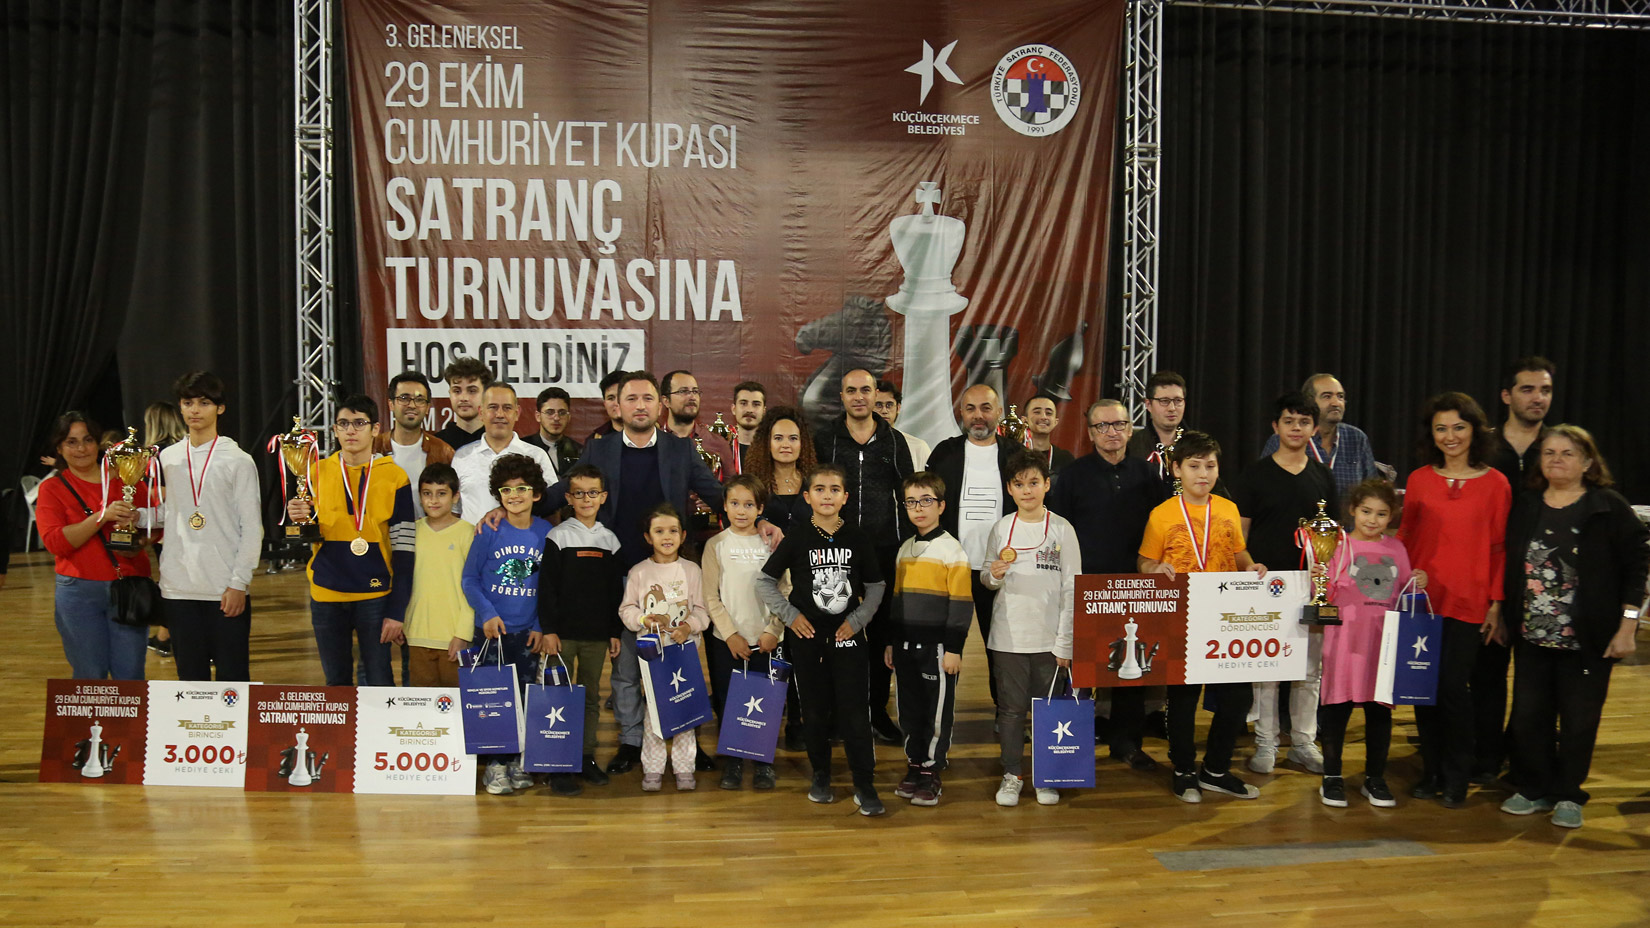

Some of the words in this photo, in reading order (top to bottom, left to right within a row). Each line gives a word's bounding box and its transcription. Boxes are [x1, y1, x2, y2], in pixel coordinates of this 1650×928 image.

[386, 24, 402, 47] 3.
[408, 24, 523, 50] GELENEKSEL
[385, 61, 430, 108] 29
[440, 55, 524, 109] EKİM
[993, 66, 1005, 103] TÜRKİYE
[1006, 47, 1044, 63] SATRANÇ
[1049, 51, 1078, 106] FEDERASYONU
[892, 111, 980, 125] KÜÇÜKÇEKMECE
[907, 125, 966, 136] BELEDİYESİ
[385, 112, 607, 167] CUMHURİYET
[617, 122, 737, 169] KUPASI
[386, 177, 622, 254] SATRANÇ
[385, 257, 743, 322] TURNUVASINA
[494, 545, 525, 559] DINOS
[809, 548, 852, 566] CHAMP
[1107, 580, 1114, 588] 3.
[1115, 579, 1156, 589] GELENEKSEL
[1083, 591, 1093, 600] 29
[1094, 589, 1111, 600] EKİM
[1112, 588, 1154, 600] CUMHURİYET
[1155, 589, 1180, 599] KUPASI
[1086, 601, 1127, 616] SATRANÇ
[1128, 601, 1177, 613] TURNUVASI
[1220, 622, 1280, 632] DÖRDÜNCÜSÜ
[835, 640, 857, 648] NASA
[76, 686, 83, 695] 3.
[83, 686, 120, 696] GELENEKSEL
[280, 692, 287, 700] 3.
[287, 692, 326, 702] GELENEKSEL
[55, 695, 64, 704] 29
[64, 694, 80, 705] EKİM
[80, 694, 118, 705] CUMHURİYET
[119, 695, 141, 705] KUPASI
[56, 705, 93, 718] SATRANÇ
[94, 706, 138, 718] TURNUVASI
[257, 702, 267, 711] 29
[267, 701, 284, 711] EKİM
[284, 701, 325, 712] CUMHURİYET
[326, 702, 349, 712] KUPASI
[259, 712, 299, 726] SATRANÇ
[299, 712, 346, 725] TURNUVASI
[416, 721, 423, 729] A
